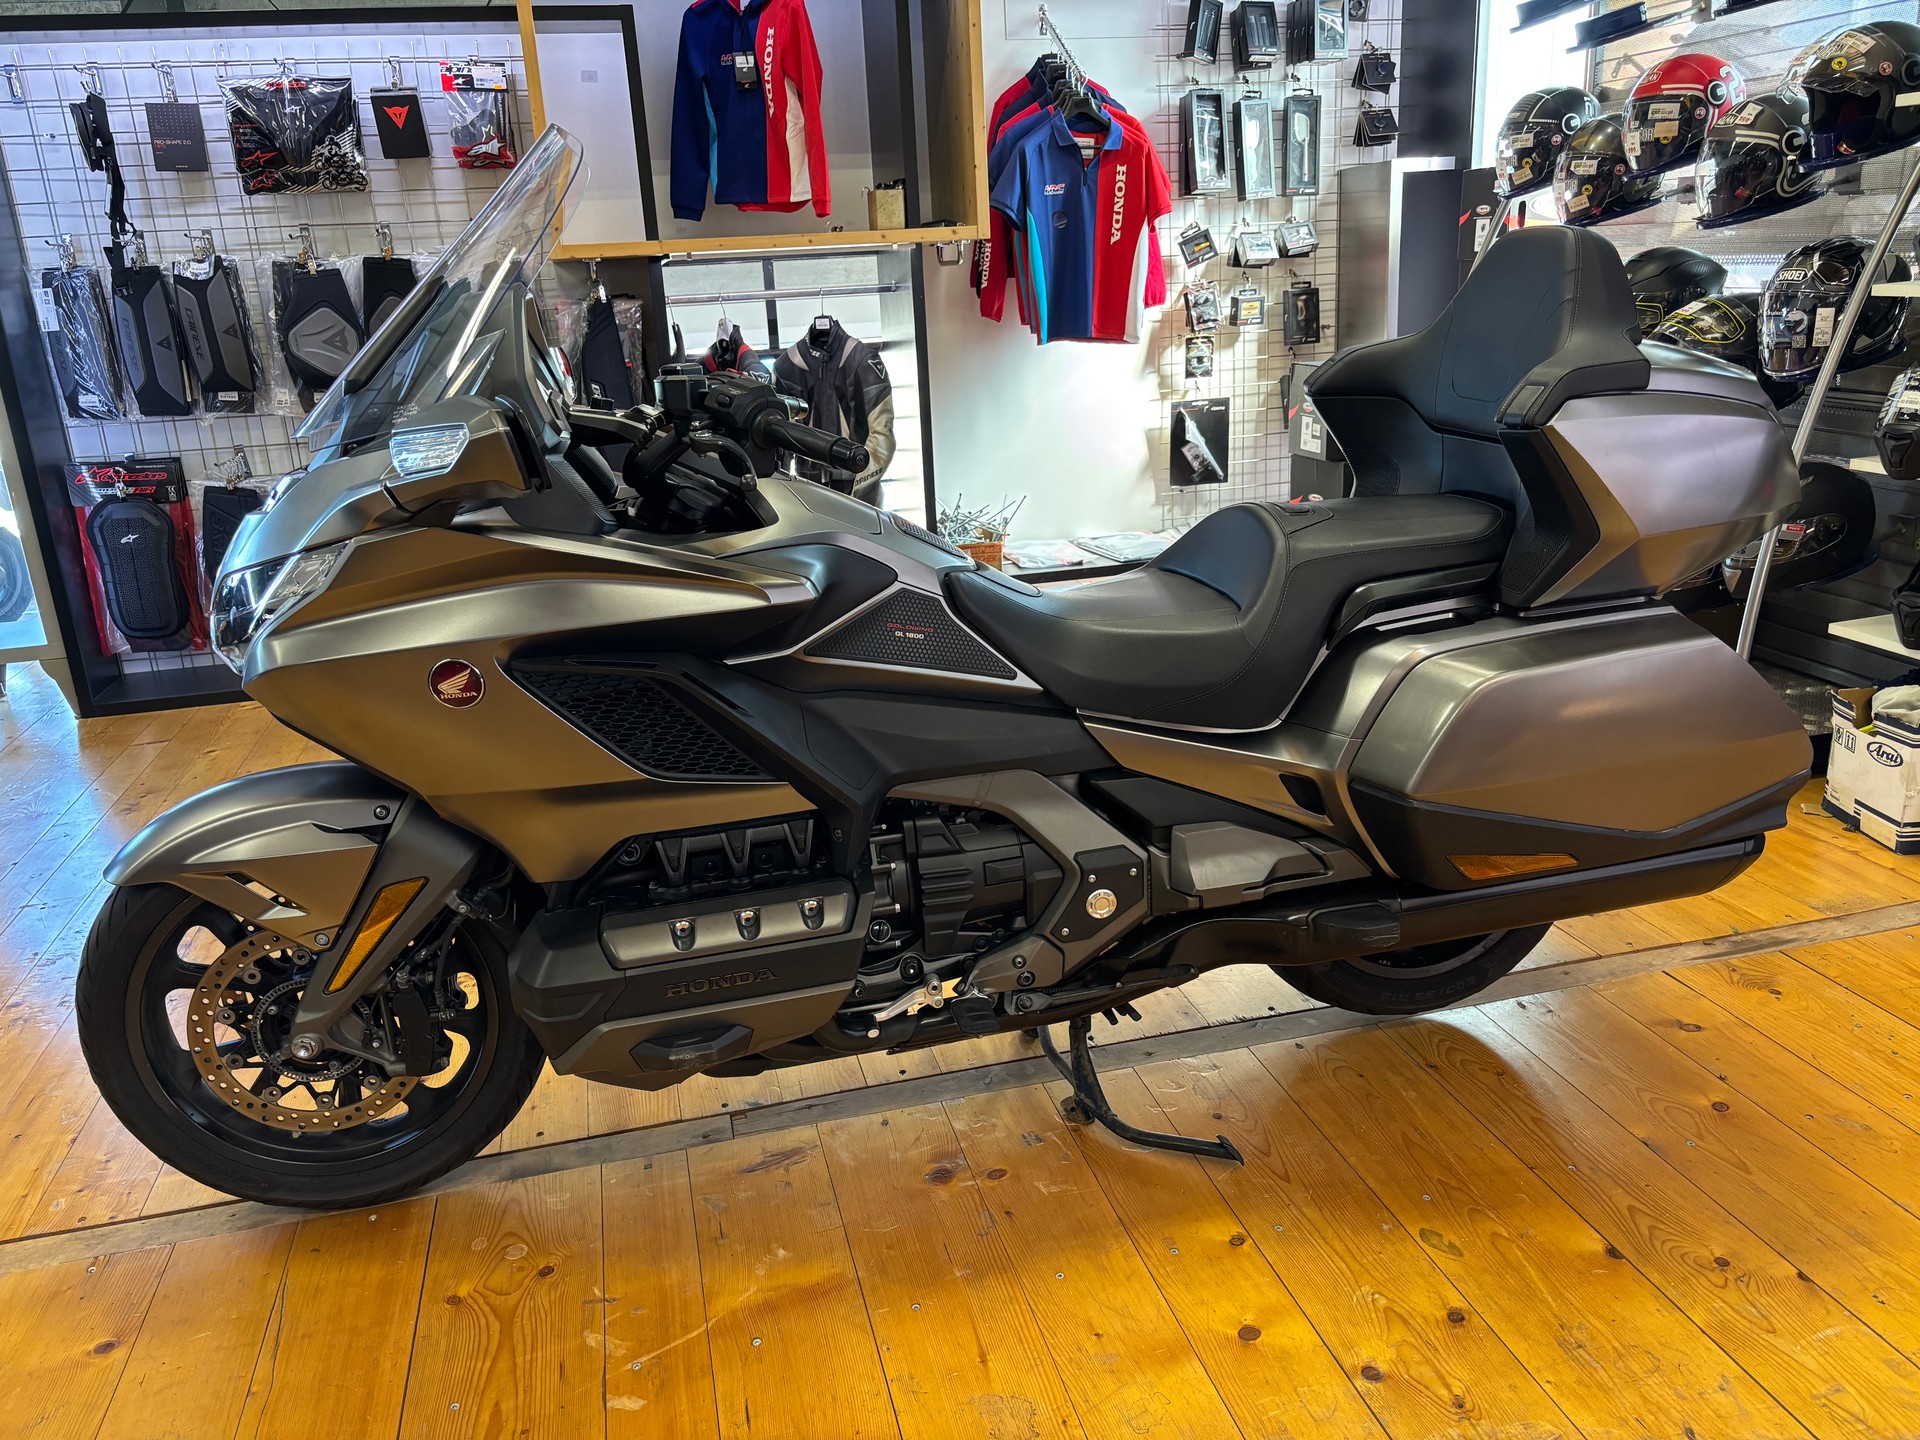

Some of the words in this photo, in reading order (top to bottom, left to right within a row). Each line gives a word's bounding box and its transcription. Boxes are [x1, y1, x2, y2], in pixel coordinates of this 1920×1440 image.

[763, 26, 775, 118] HONDA
[1110, 164, 1127, 245] HONDA
[981, 242, 992, 289] HONDA
[1777, 270, 1805, 281] SHOEI
[887, 622, 934, 633] GOLDWING
[905, 632, 925, 640] 1800
[440, 691, 478, 699] HONDA
[1869, 743, 1900, 764] Arai
[664, 968, 778, 998] HONDA
